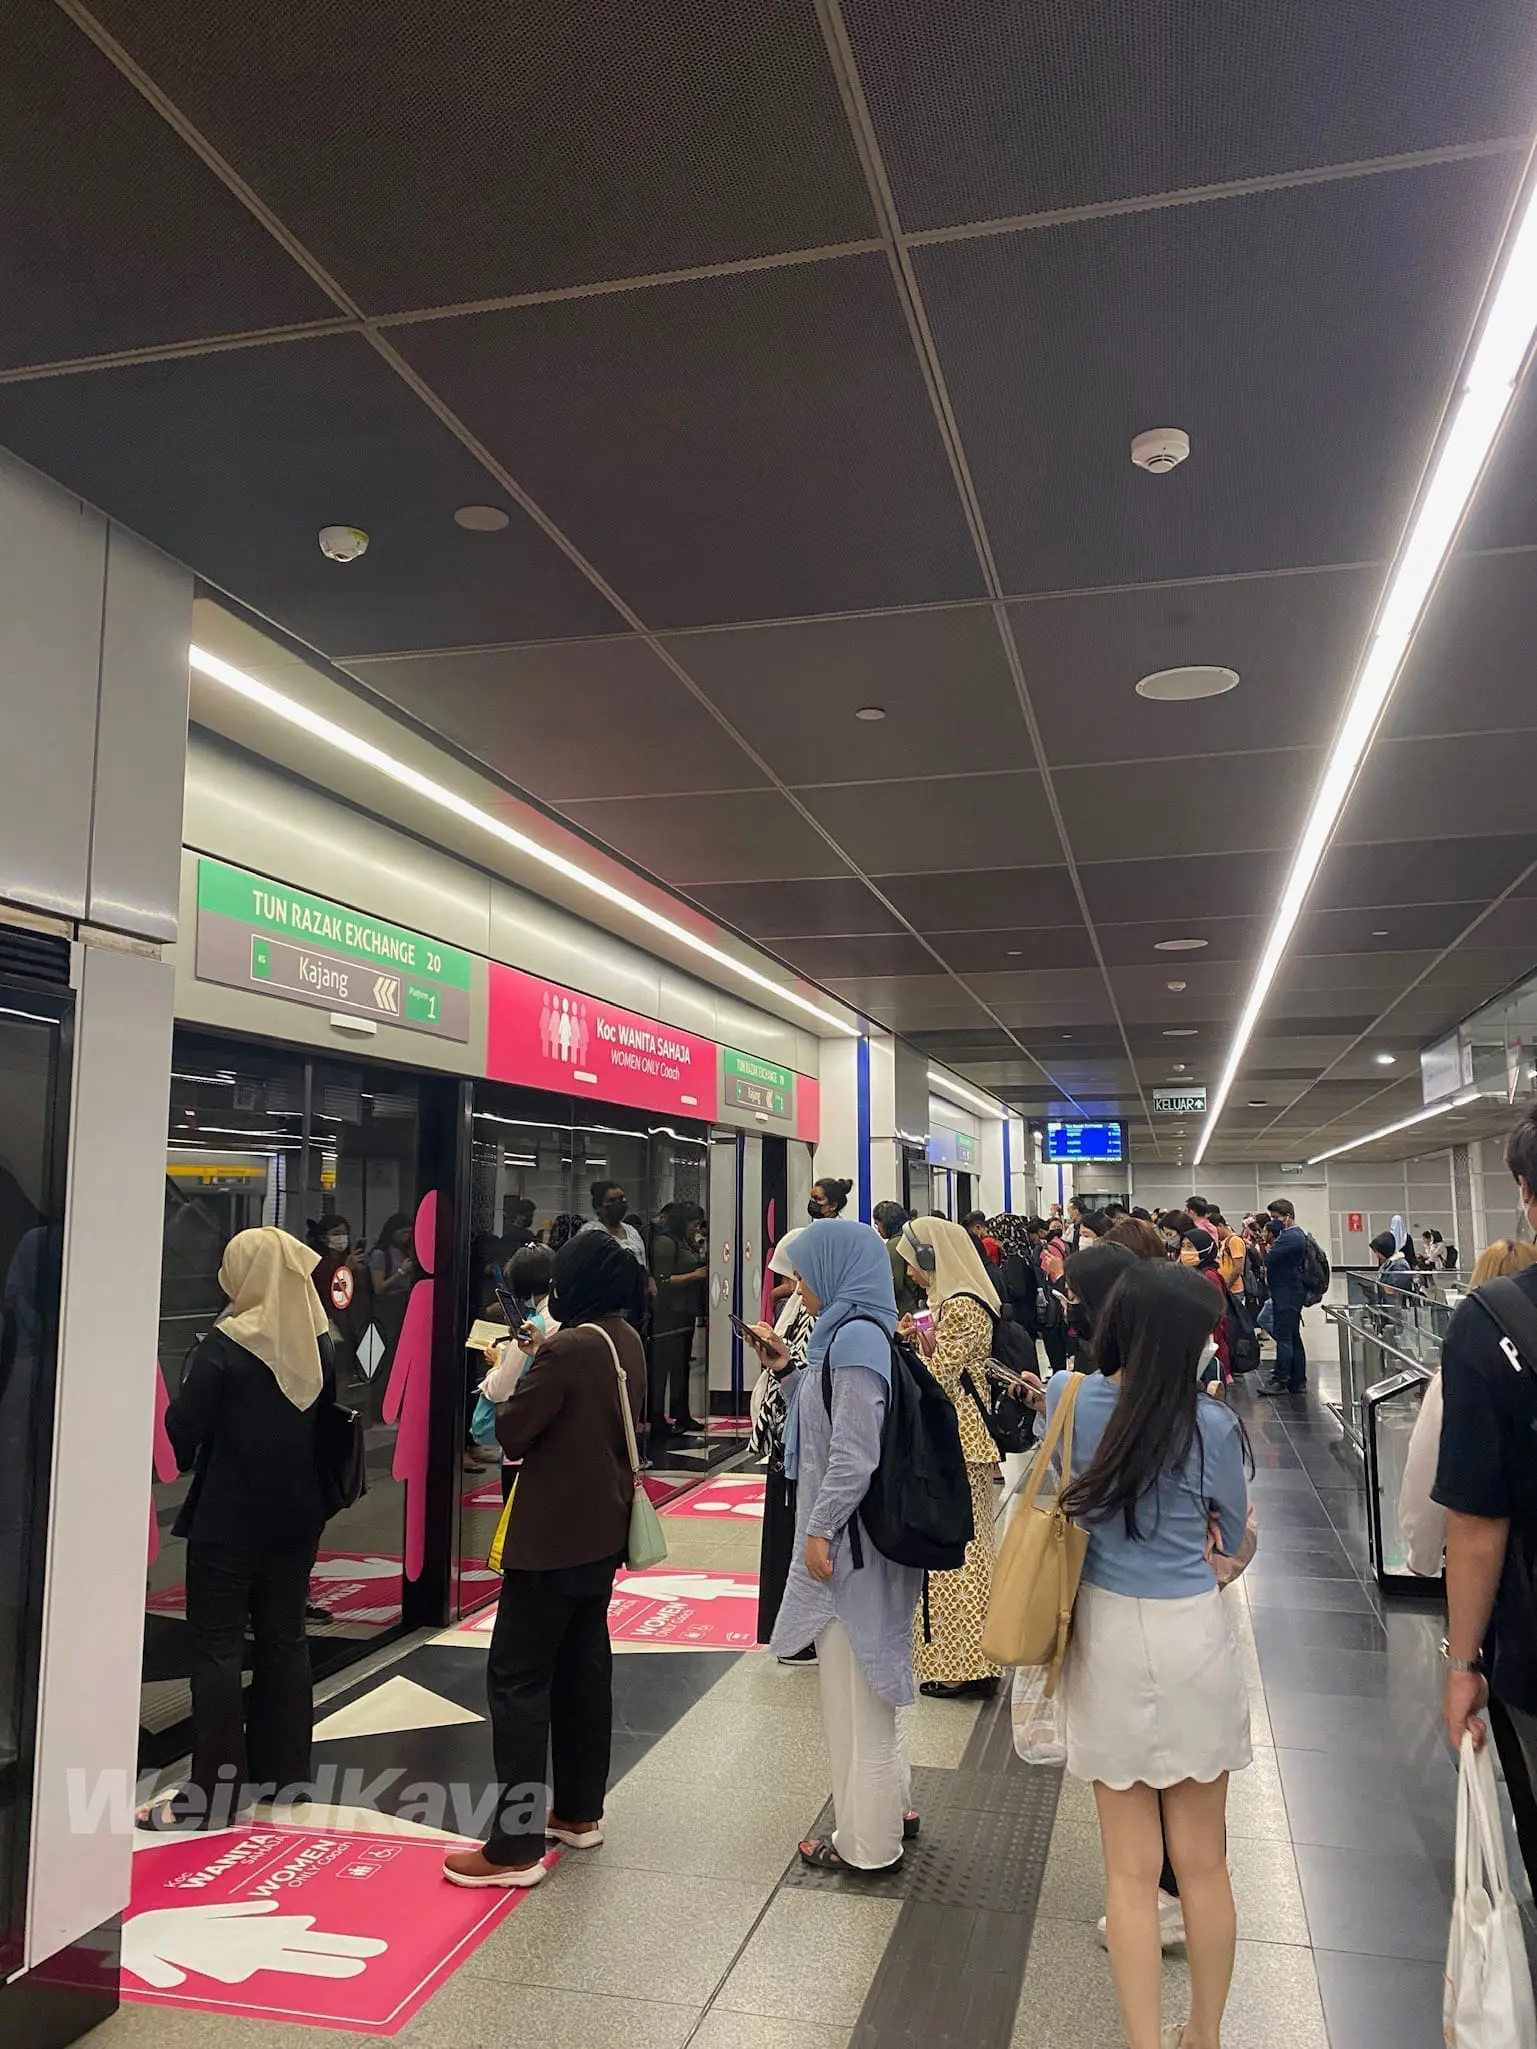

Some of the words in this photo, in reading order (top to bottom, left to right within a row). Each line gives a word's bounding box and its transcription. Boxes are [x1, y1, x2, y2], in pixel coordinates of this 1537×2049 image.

[253, 890, 287, 924] TUN
[291, 903, 342, 943] RAZAK
[346, 923, 416, 965] EXCHANGE
[426, 952, 441, 973] 20
[299, 955, 349, 997] Kajang
[427, 996, 436, 1019] 1
[596, 1018, 616, 1042] Koc
[617, 1025, 656, 1054] WANITA
[657, 1037, 691, 1065] SAHAJA
[610, 1049, 641, 1069] WOMEN
[641, 1058, 660, 1076] ONLY
[659, 1063, 680, 1081] Coach
[1155, 1098, 1194, 1111] KELUAR
[631, 1602, 689, 1636] WOMEN
[179, 1834, 275, 1889] WANITA
[241, 1835, 290, 1865] SAHAJA
[248, 1839, 338, 1897] WOMEN
[288, 1864, 321, 1888] ONLY
[318, 1840, 353, 1865] Coach
[163, 1872, 193, 1889] Koc
